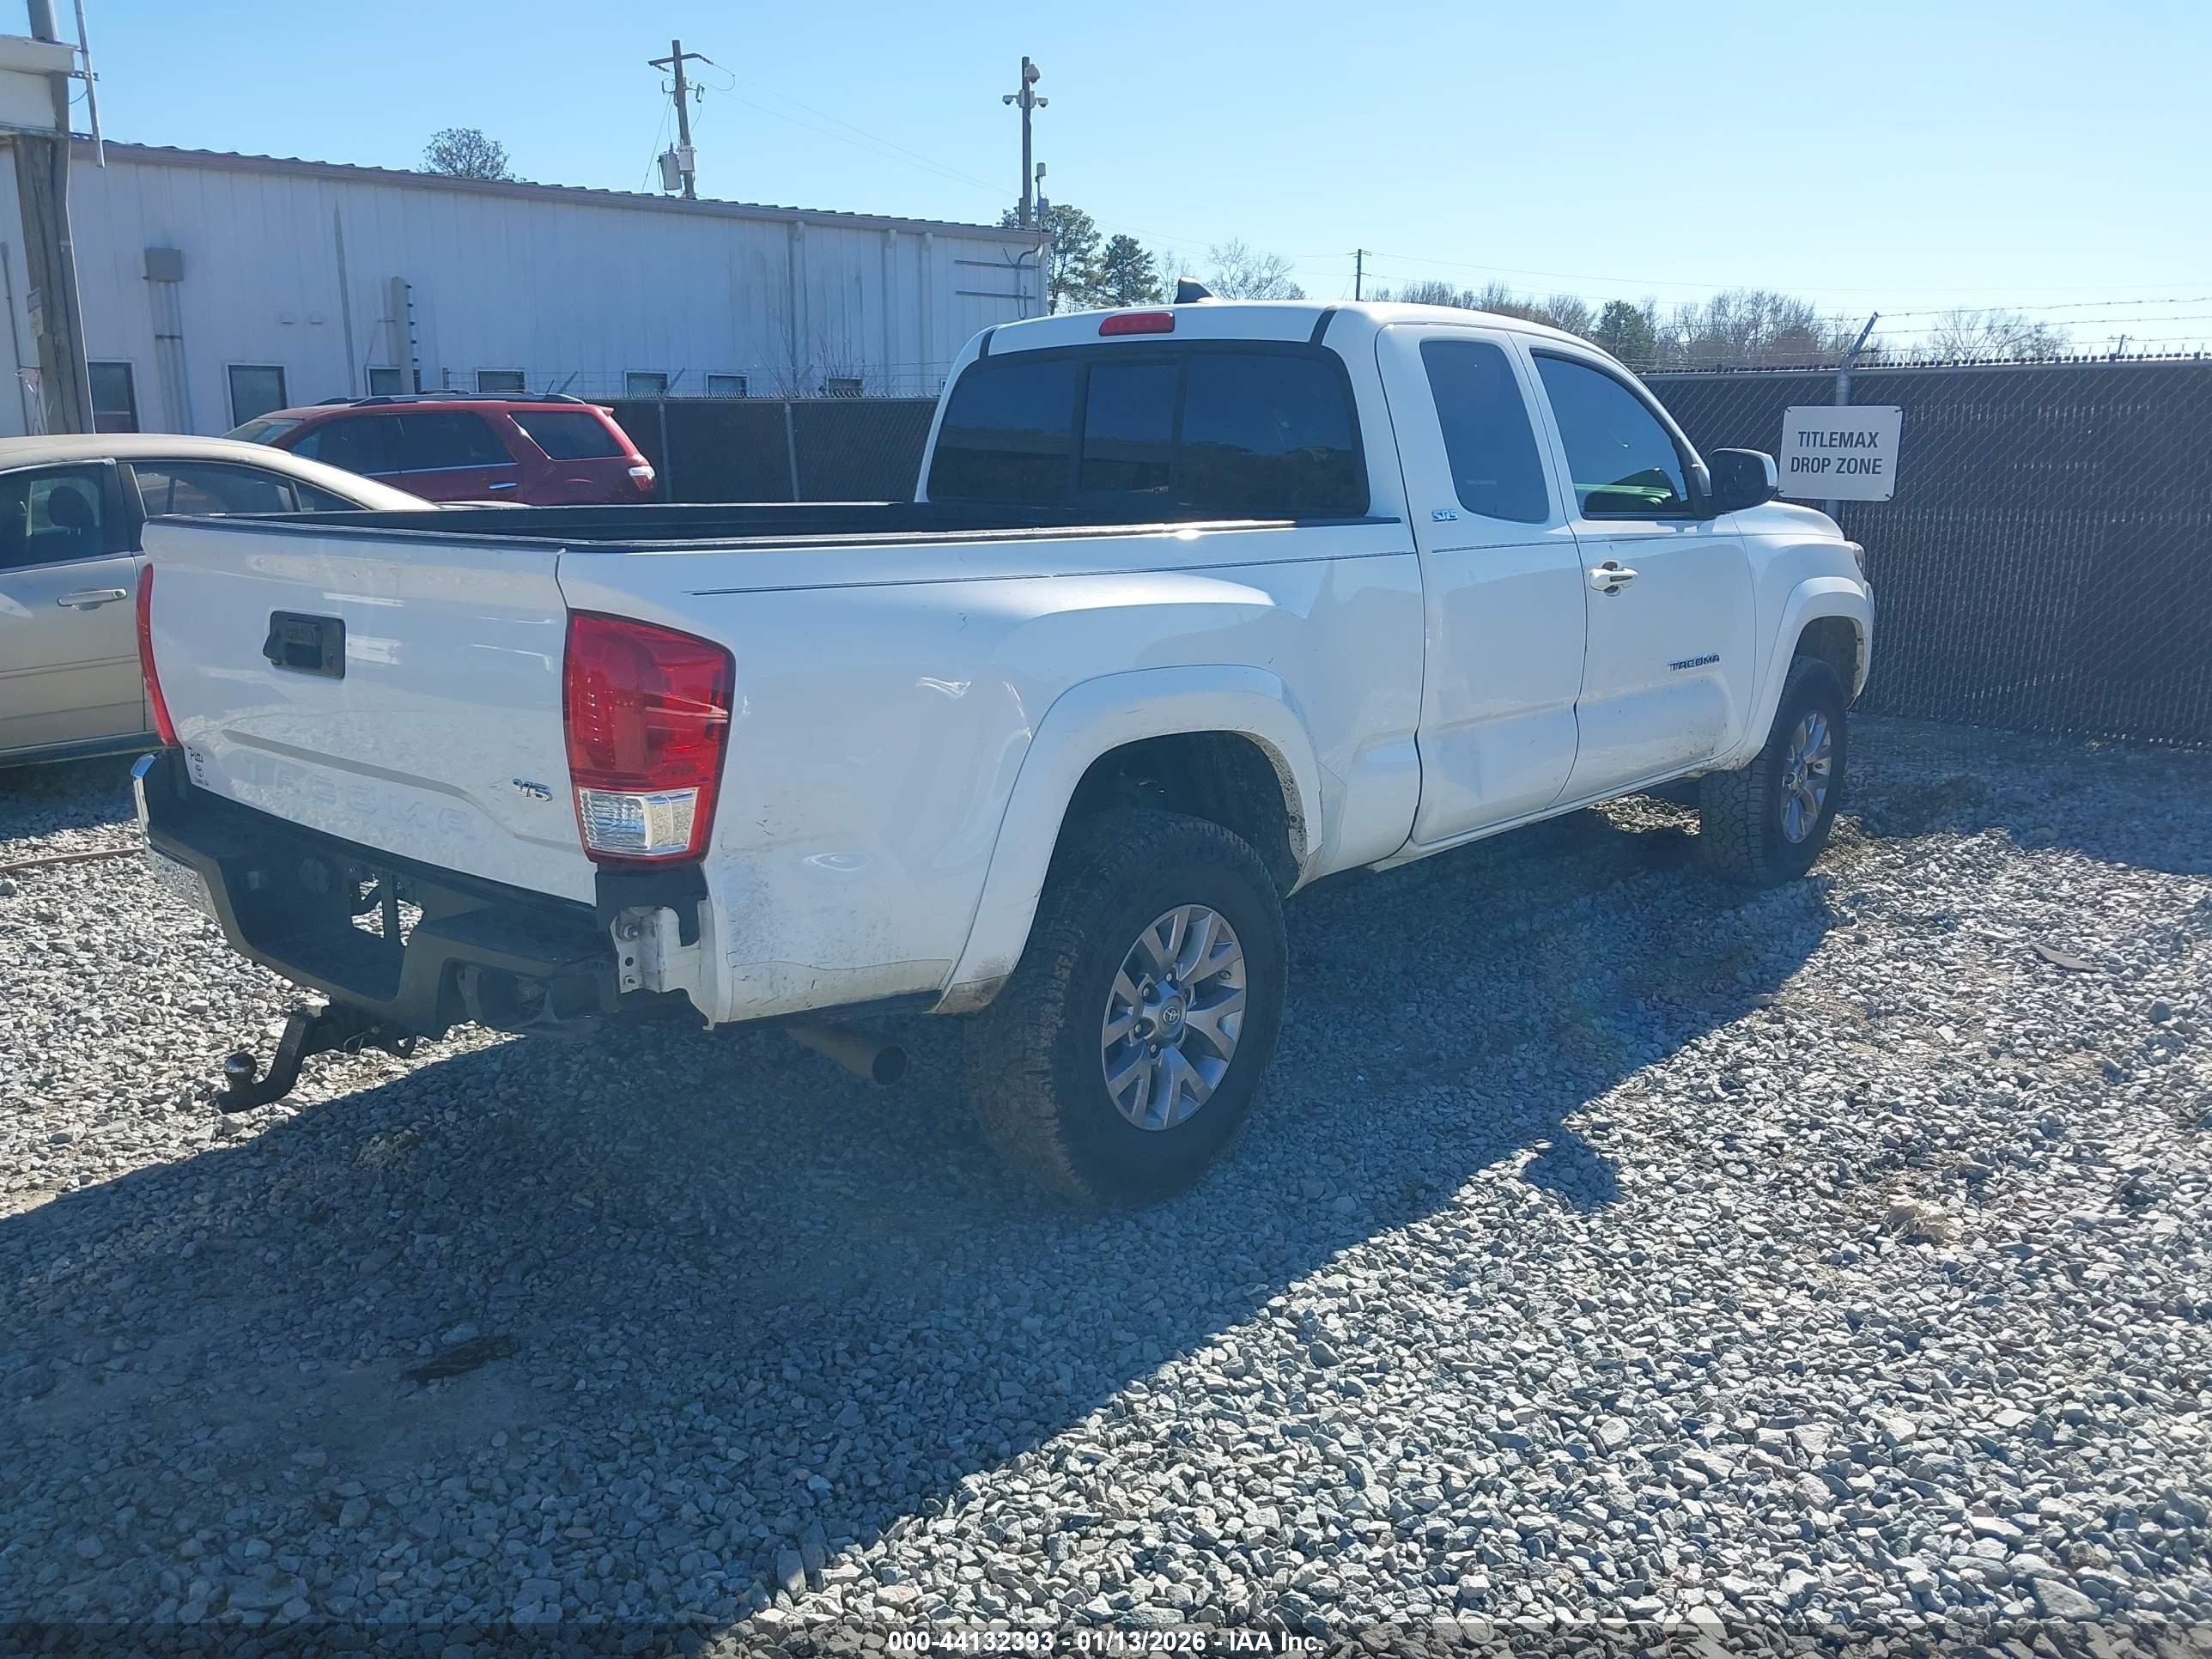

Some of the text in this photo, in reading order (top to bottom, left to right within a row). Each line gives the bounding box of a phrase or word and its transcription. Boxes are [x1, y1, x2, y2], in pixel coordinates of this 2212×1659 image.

[1797, 431, 1879, 448] TITLEMAX
[1790, 457, 1883, 475] DROP ZONE
[1668, 653, 1720, 671] TACOMA
